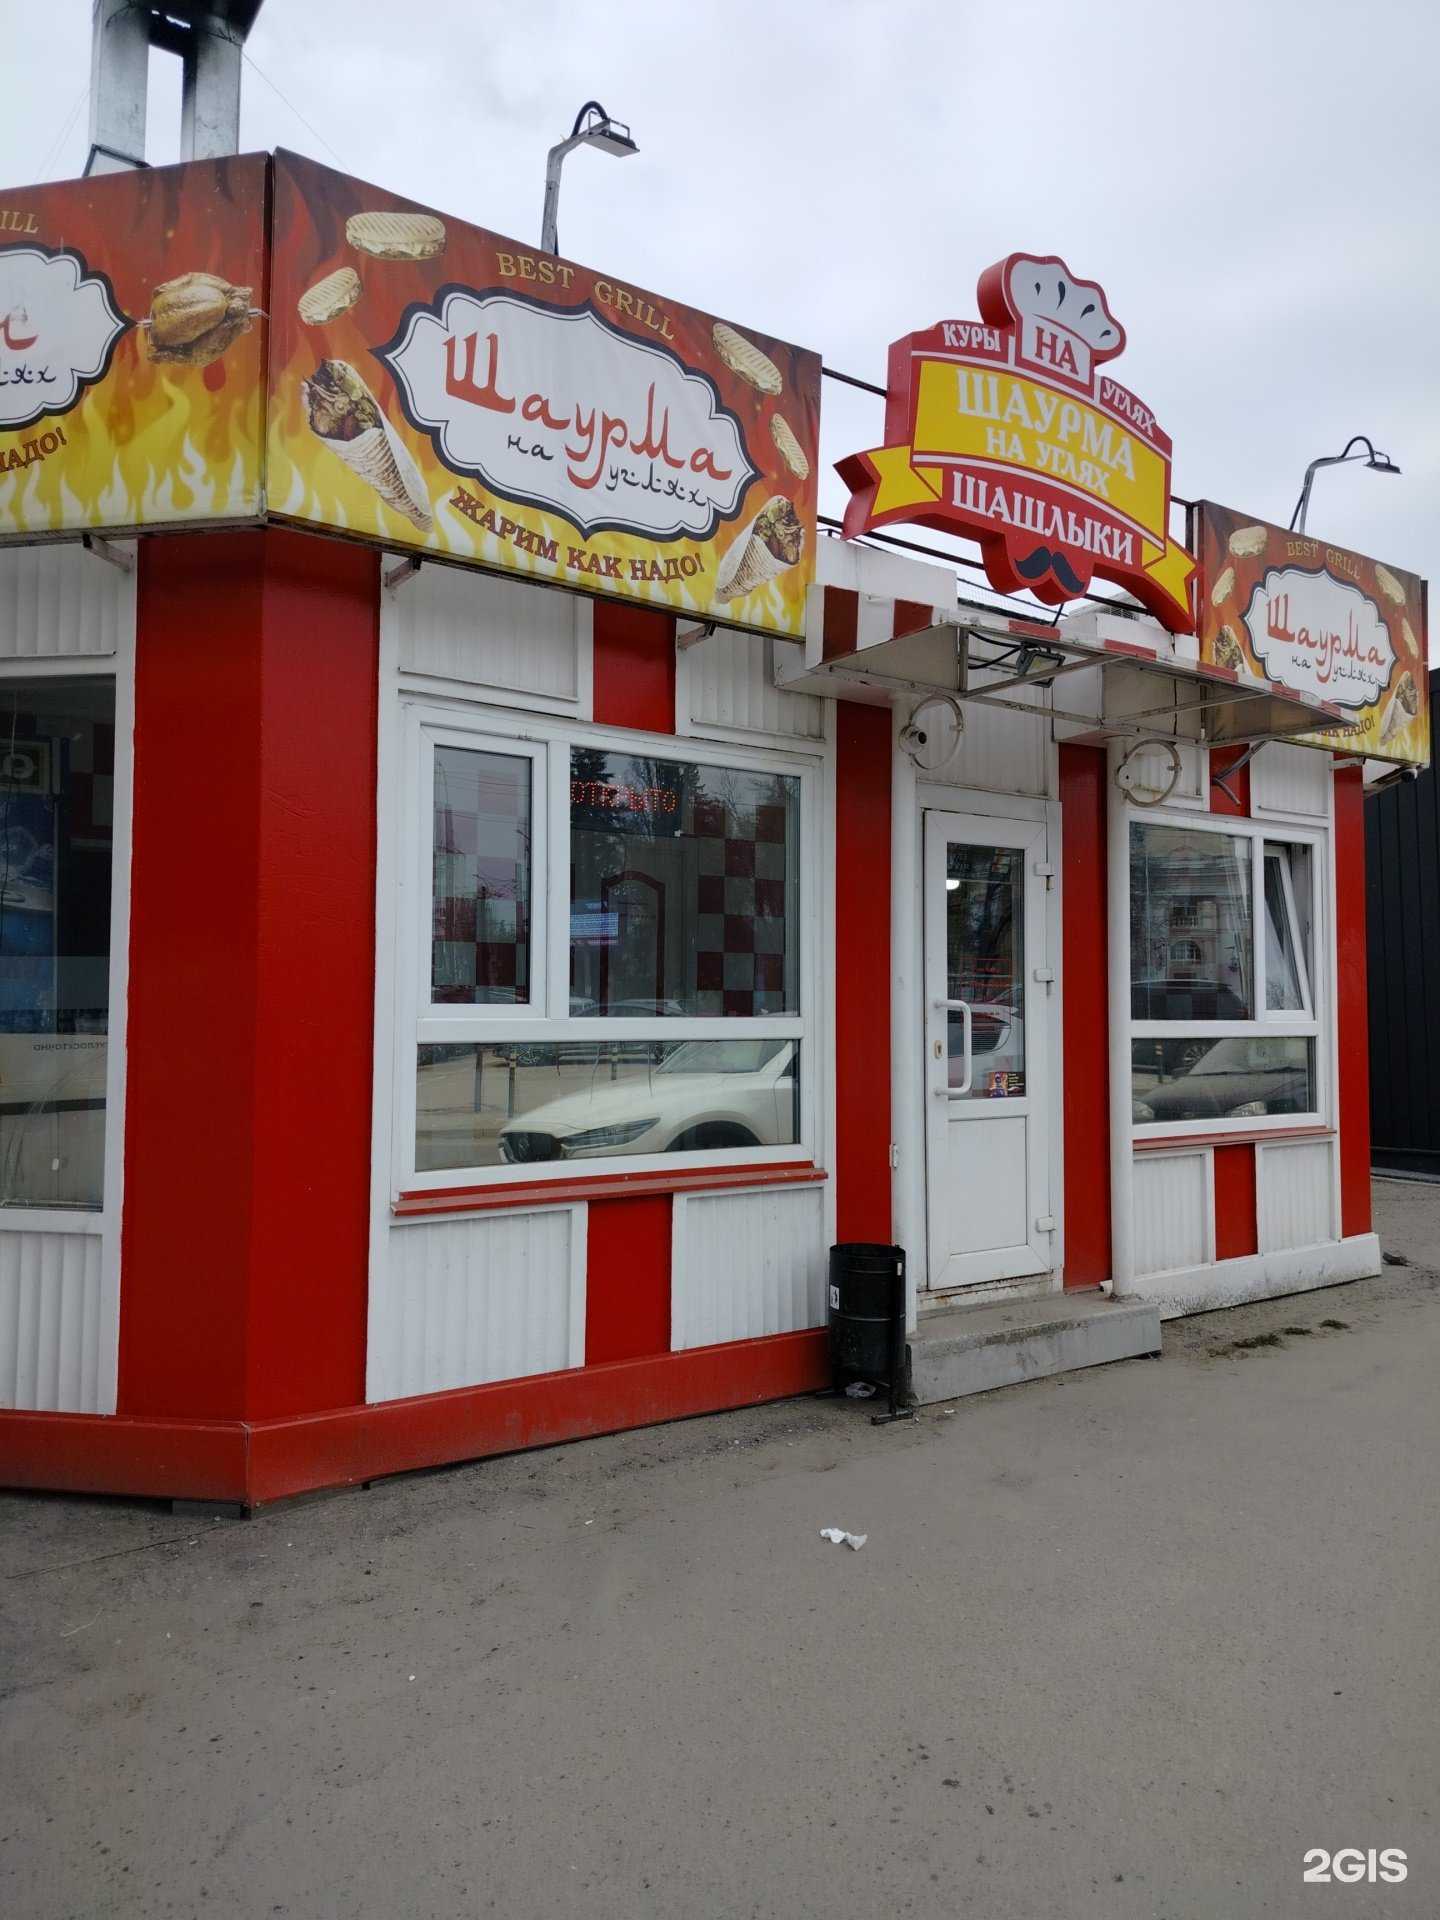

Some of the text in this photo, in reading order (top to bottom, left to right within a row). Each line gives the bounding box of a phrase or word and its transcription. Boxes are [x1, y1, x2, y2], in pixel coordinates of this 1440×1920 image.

[495, 252, 675, 340] BEST GRILL
[942, 322, 1157, 439] КУРЫ НА УГЛЯХ
[956, 368, 1136, 482] ШАУРМА
[986, 427, 1110, 498] НА УГЛЯХ
[507, 433, 707, 508] на углях
[449, 485, 705, 584] ЖАРИМ КАК НАДО!
[952, 470, 1134, 566] ШАШЛЫКИ
[1286, 541, 1361, 580] BEST GRILL
[1291, 655, 1312, 670] на
[570, 781, 678, 813] ОТКРЫТО
